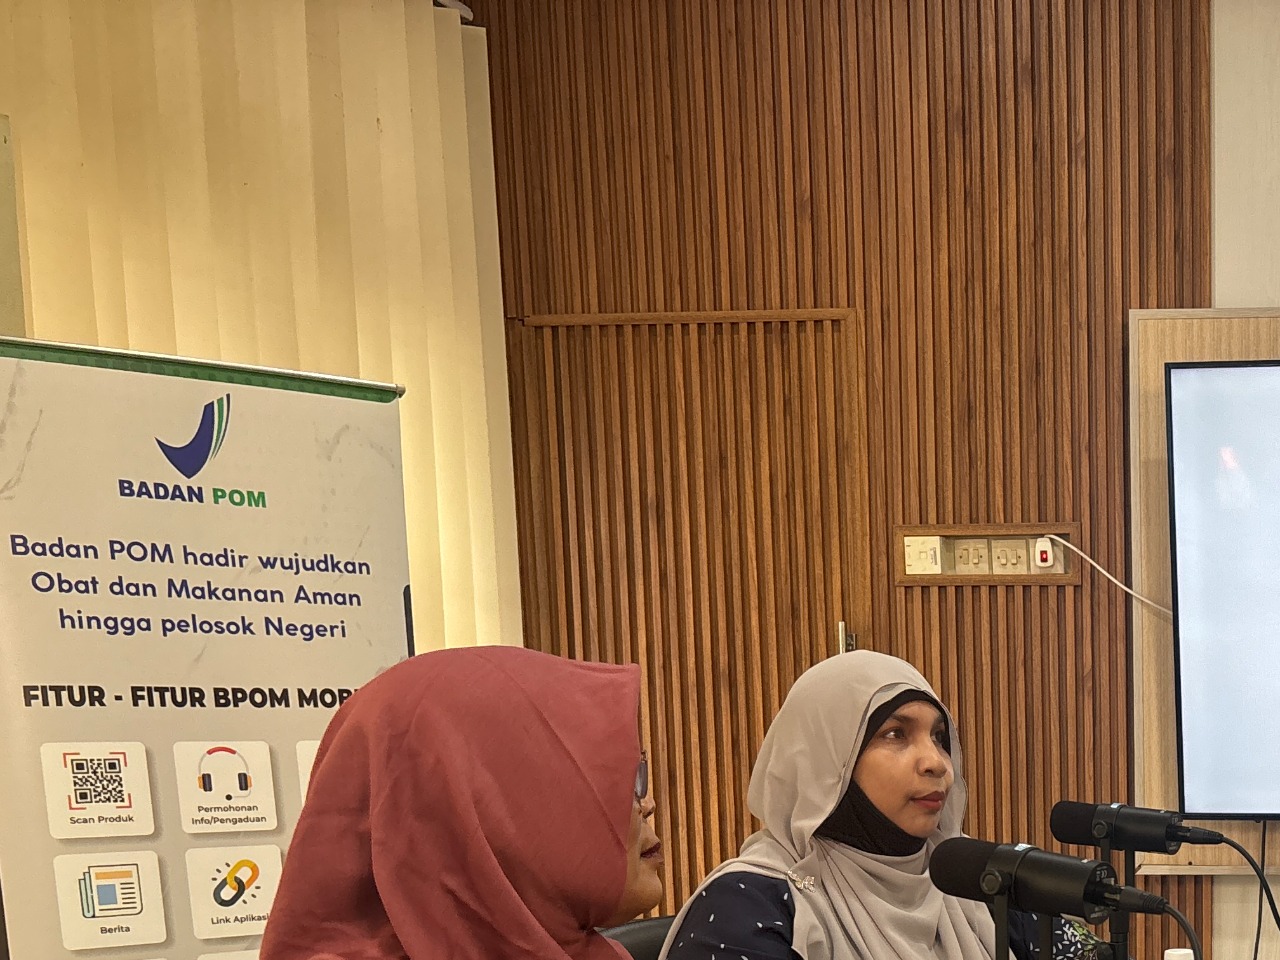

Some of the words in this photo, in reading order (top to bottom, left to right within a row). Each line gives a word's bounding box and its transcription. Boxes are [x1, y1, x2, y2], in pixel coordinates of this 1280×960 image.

[119, 479, 204, 503] BADAN
[212, 488, 267, 508] POM
[10, 535, 98, 560] Badan
[109, 541, 174, 564] POM
[183, 546, 248, 568] hadir
[258, 553, 371, 576] wujudkan
[31, 572, 98, 595] Obat
[109, 576, 156, 598] dan
[167, 579, 284, 603] Makanan
[295, 586, 361, 607] Aman
[59, 609, 151, 636] hingga
[162, 614, 254, 636] pelosok
[265, 617, 346, 641] Negeri
[23, 685, 106, 707] FITUR
[131, 686, 206, 707] FITUR
[214, 688, 290, 708] BPOM
[198, 804, 258, 814] Permohonan
[70, 815, 95, 825] Scan
[97, 814, 134, 823] Produk
[191, 814, 266, 826] Info/Pengaduan
[211, 916, 231, 925] Link
[100, 924, 130, 935] Berita
